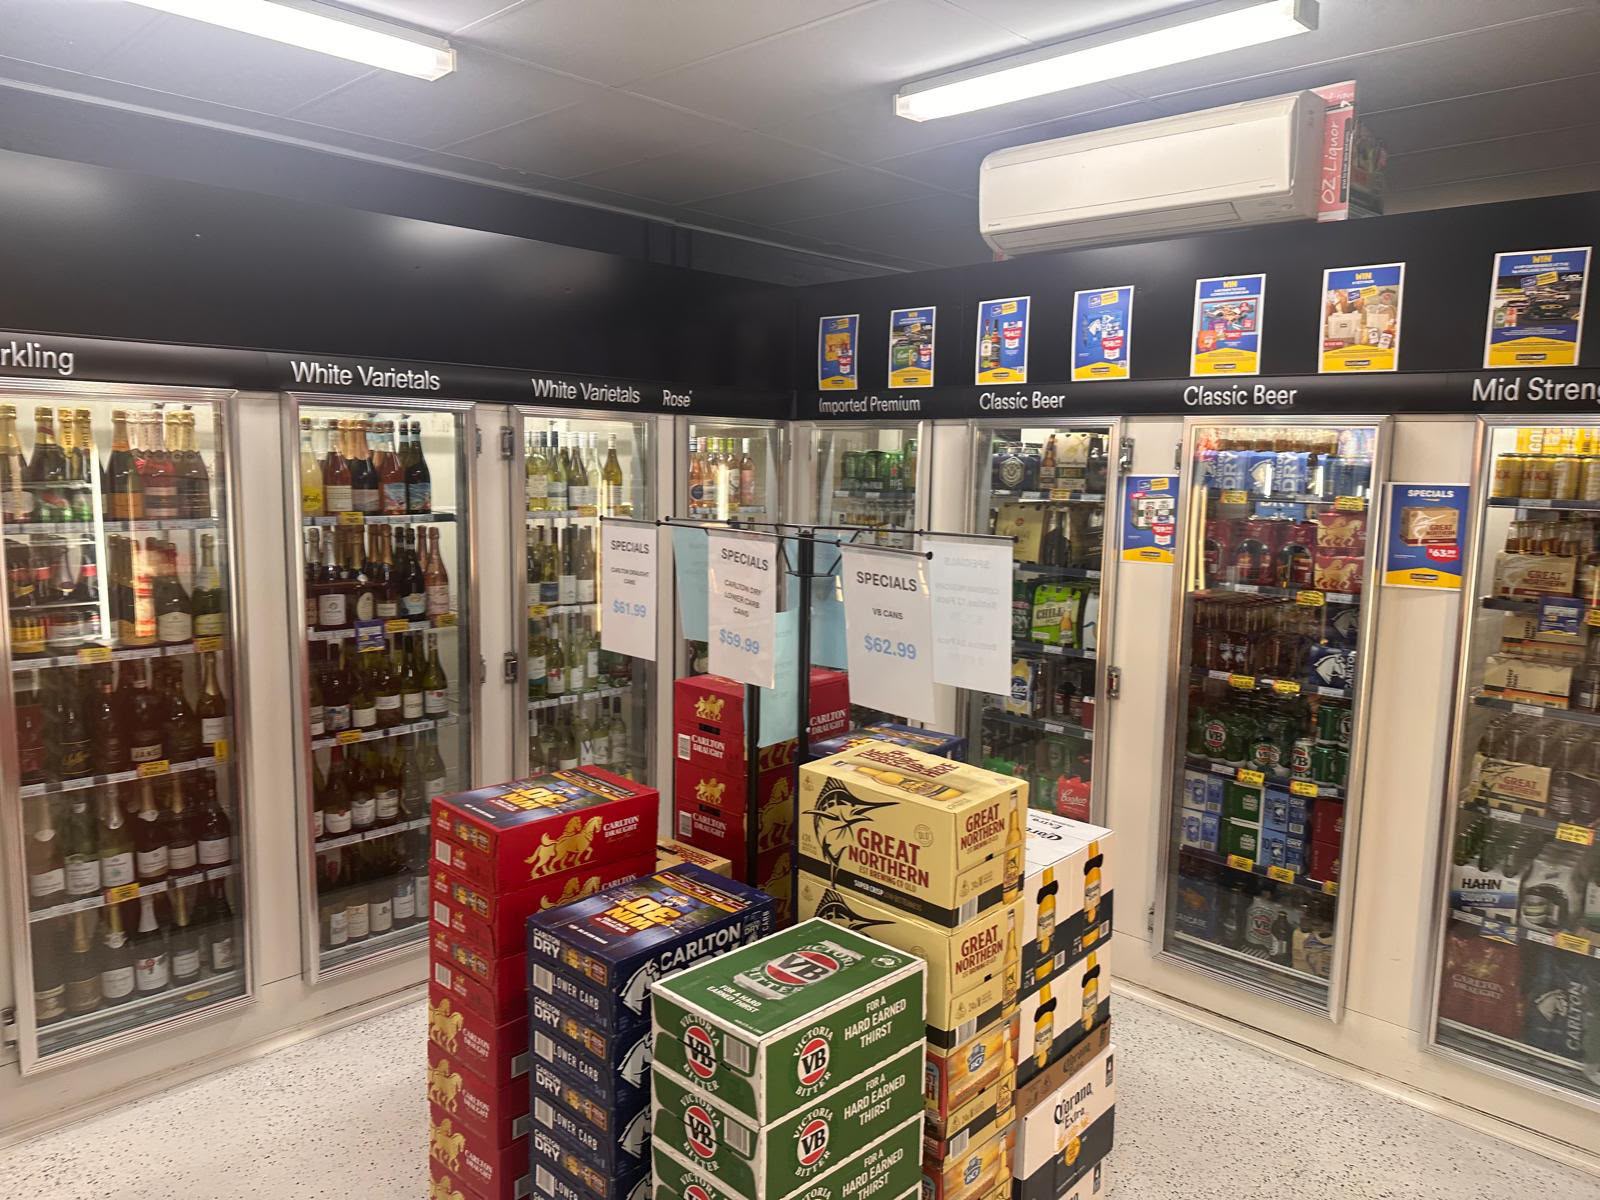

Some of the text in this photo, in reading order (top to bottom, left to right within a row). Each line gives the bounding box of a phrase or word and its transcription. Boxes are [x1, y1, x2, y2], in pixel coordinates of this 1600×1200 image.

[1323, 120, 1344, 172] Liquor
[1321, 175, 1340, 204] OZ
[1355, 272, 1372, 281] WIN
[290, 361, 441, 391] White Varietals
[532, 378, 641, 404] White Varietals
[979, 391, 1066, 410] Classic Beer
[1183, 384, 1298, 406] Classic Beer
[1472, 376, 1600, 404] Mid Stren
[819, 395, 921, 415] Imported Premium
[1223, 453, 1238, 488] DRY
[1282, 452, 1298, 491] DRY
[1407, 489, 1455, 498] SPECIALS
[611, 540, 650, 554] SPECIALS
[721, 548, 769, 571] SPECIALS
[724, 579, 749, 593] CARLTON
[856, 571, 917, 592] SPECIALS
[1527, 570, 1563, 580] GREAT
[613, 599, 647, 618] $61.99
[883, 609, 903, 620] CANS
[719, 629, 760, 655] $59.99
[864, 633, 916, 660] $62.99
[810, 709, 846, 727] CARLTON
[811, 719, 845, 735] DRAUGHT
[691, 734, 726, 751] CARLTON
[693, 742, 724, 759] DRAUGHT
[1504, 776, 1537, 789] GREAT
[603, 815, 639, 831] CARLTON
[605, 824, 637, 838] DRAUGHT
[692, 813, 727, 830] CARLTON
[694, 822, 725, 838] DRAUGHT
[966, 803, 1000, 833] GREAT
[857, 828, 920, 866] GREAT
[960, 818, 1005, 850] NORTHERN
[848, 845, 929, 888] NORTHERN
[1461, 878, 1502, 890] HAHN
[604, 906, 657, 931] WIN
[533, 928, 560, 946] CARLTON
[533, 935, 560, 958] DRY
[660, 922, 741, 971] CARLTON
[961, 925, 998, 957] GREAT
[778, 953, 831, 981] VB
[955, 939, 1003, 975] NORTHERN
[553, 974, 599, 1010] LOWER CARB
[717, 984, 735, 995] FOR
[741, 994, 764, 1007] HARD
[1452, 974, 1504, 993] CARLTON
[534, 996, 560, 1016] CARLTON
[706, 985, 760, 1013] EARNED THIRST
[866, 996, 887, 1013] FOR A
[534, 1004, 560, 1028] DRY
[844, 998, 907, 1040] HARD EARNED
[1566, 981, 1583, 1050] CARLTON
[462, 1028, 490, 1050] CARLTON
[680, 1013, 720, 1047] VICTORIA
[792, 1026, 834, 1057] VICTORIA
[860, 1021, 893, 1048] THIRST
[553, 1042, 599, 1081] LOWER CARB
[688, 1034, 713, 1069] VB
[801, 1048, 826, 1075] VB
[535, 1064, 561, 1084] CARLTON
[536, 1072, 561, 1096] DRY
[682, 1063, 720, 1092] BITTER
[795, 1071, 832, 1097] BITTER
[865, 1073, 886, 1091] FOR A
[844, 1095, 870, 1120] HARD
[871, 1074, 906, 1103] EARNED
[1054, 1082, 1093, 1124] Corona
[680, 1093, 720, 1128] VICTORIA
[793, 1107, 833, 1139] VICTORIA
[859, 1097, 892, 1125] THIRST
[1064, 1107, 1086, 1129] Extra
[534, 1128, 560, 1151] CARLTON
[553, 1109, 598, 1150] LOWER CARB
[688, 1114, 713, 1149] VB
[801, 1129, 826, 1156] VB
[464, 1149, 493, 1174] CARLTON
[534, 1137, 560, 1161] DRY
[682, 1141, 720, 1172] BITTER
[864, 1149, 884, 1168] FOR A
[795, 1150, 831, 1177] BITTER
[842, 1148, 904, 1198] HARD EARNED
[680, 1172, 718, 1200] VICTORI
[802, 1187, 832, 1200] TORIA
[858, 1172, 890, 1200] THIRST
